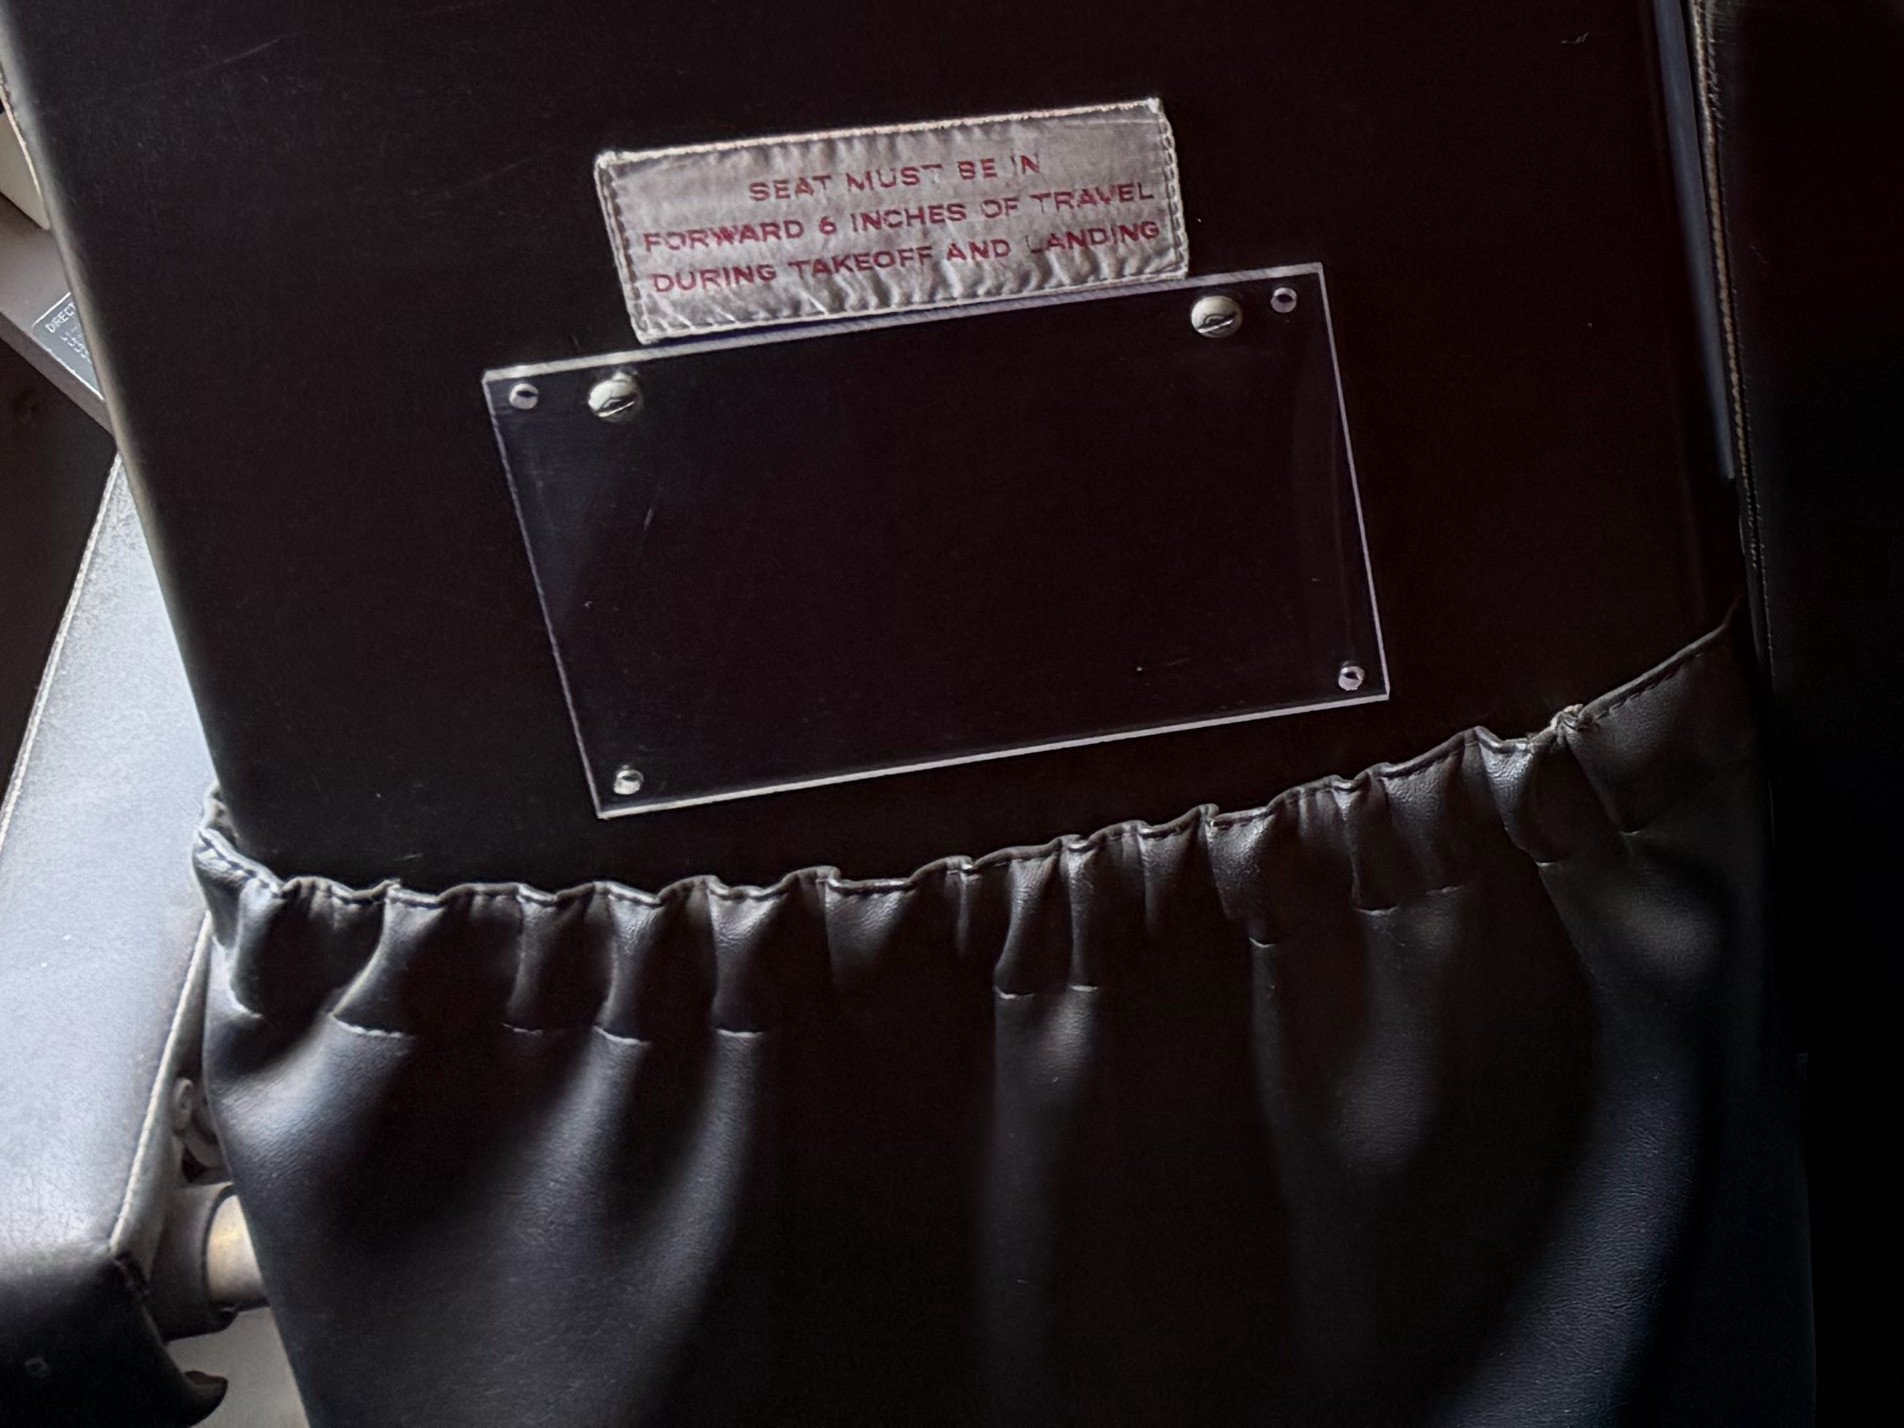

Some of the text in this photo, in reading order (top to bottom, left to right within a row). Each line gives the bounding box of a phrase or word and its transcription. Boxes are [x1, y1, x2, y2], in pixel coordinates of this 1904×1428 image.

[749, 151, 1042, 203] SEAT MUST BE IN
[644, 180, 1155, 252] FORWARD 6 INCHES OF TRAVEL
[651, 220, 1160, 293] DURING TAKEOFF AND LANDING
